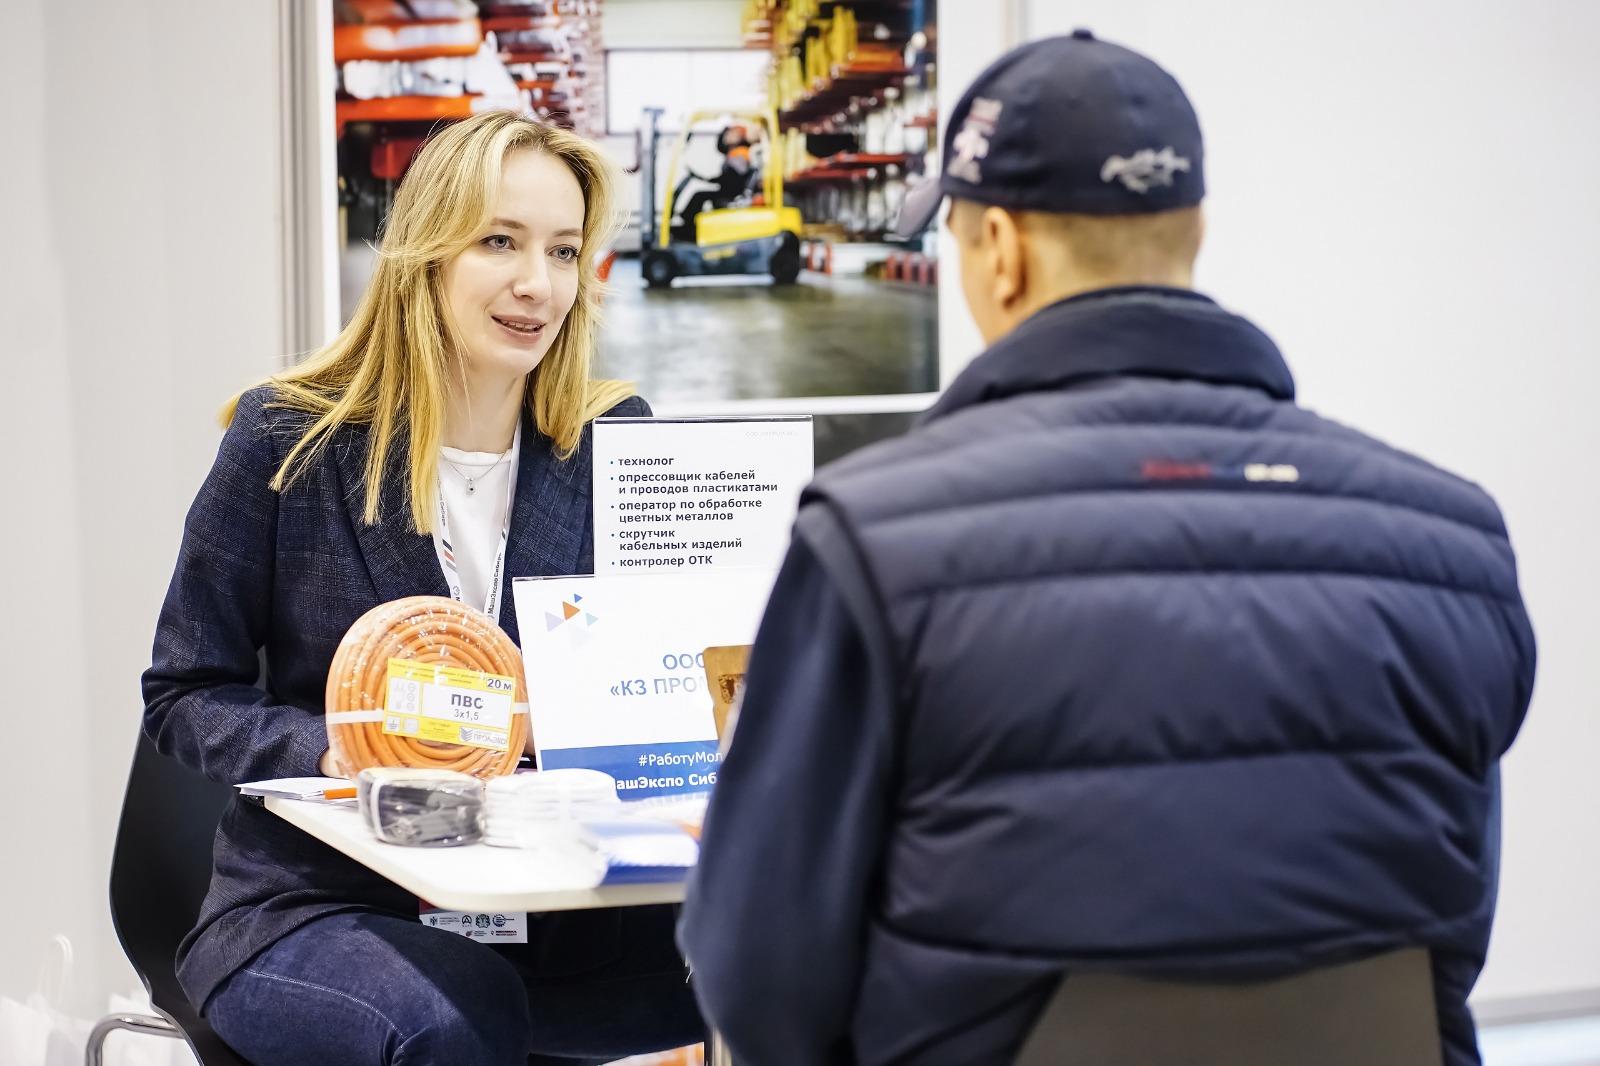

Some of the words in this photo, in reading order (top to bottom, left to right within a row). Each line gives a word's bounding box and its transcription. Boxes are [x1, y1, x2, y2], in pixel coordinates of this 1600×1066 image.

[618, 457, 674, 466] технолог
[619, 472, 701, 484] опрессовщик
[705, 470, 755, 480] кабелей
[619, 486, 626, 494] и
[630, 484, 689, 496] проводов
[693, 483, 778, 493] пластикатами
[619, 501, 676, 512] оператор
[680, 500, 695, 509] по
[699, 499, 762, 511] обработке
[619, 513, 671, 523] цветных
[676, 512, 733, 521] металлов
[619, 529, 675, 540] скрутчик
[619, 540, 687, 551] кабельных
[692, 538, 742, 549] изделий
[620, 557, 684, 569] контролер
[689, 555, 713, 565] ОТК
[487, 678, 502, 689] 20
[610, 679, 648, 696] «КЗ
[451, 693, 484, 710] ПВС
